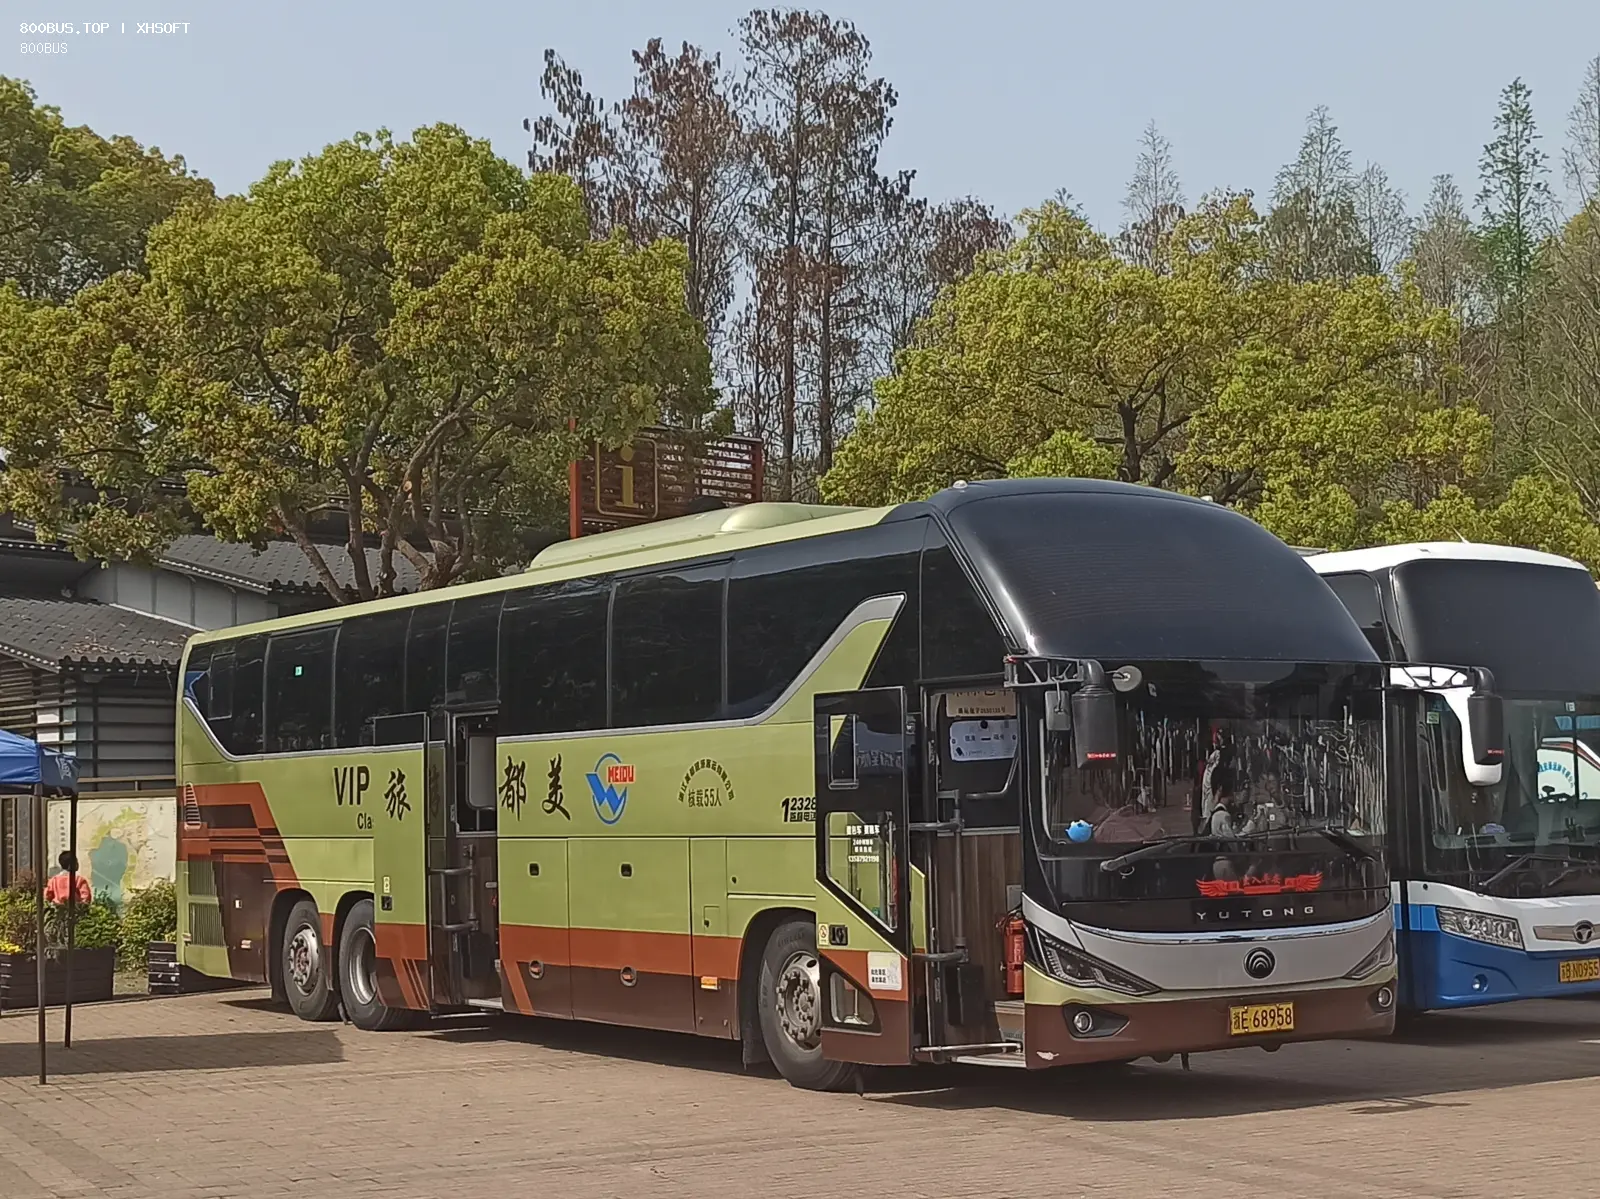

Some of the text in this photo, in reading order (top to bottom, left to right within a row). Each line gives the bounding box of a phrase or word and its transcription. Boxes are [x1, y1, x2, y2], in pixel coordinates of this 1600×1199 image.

[607, 764, 635, 783] MEIDU
[333, 765, 371, 806] VIP
[383, 767, 411, 822] 旅
[356, 812, 376, 829] Cla
[1195, 906, 1315, 921] YUTONG
